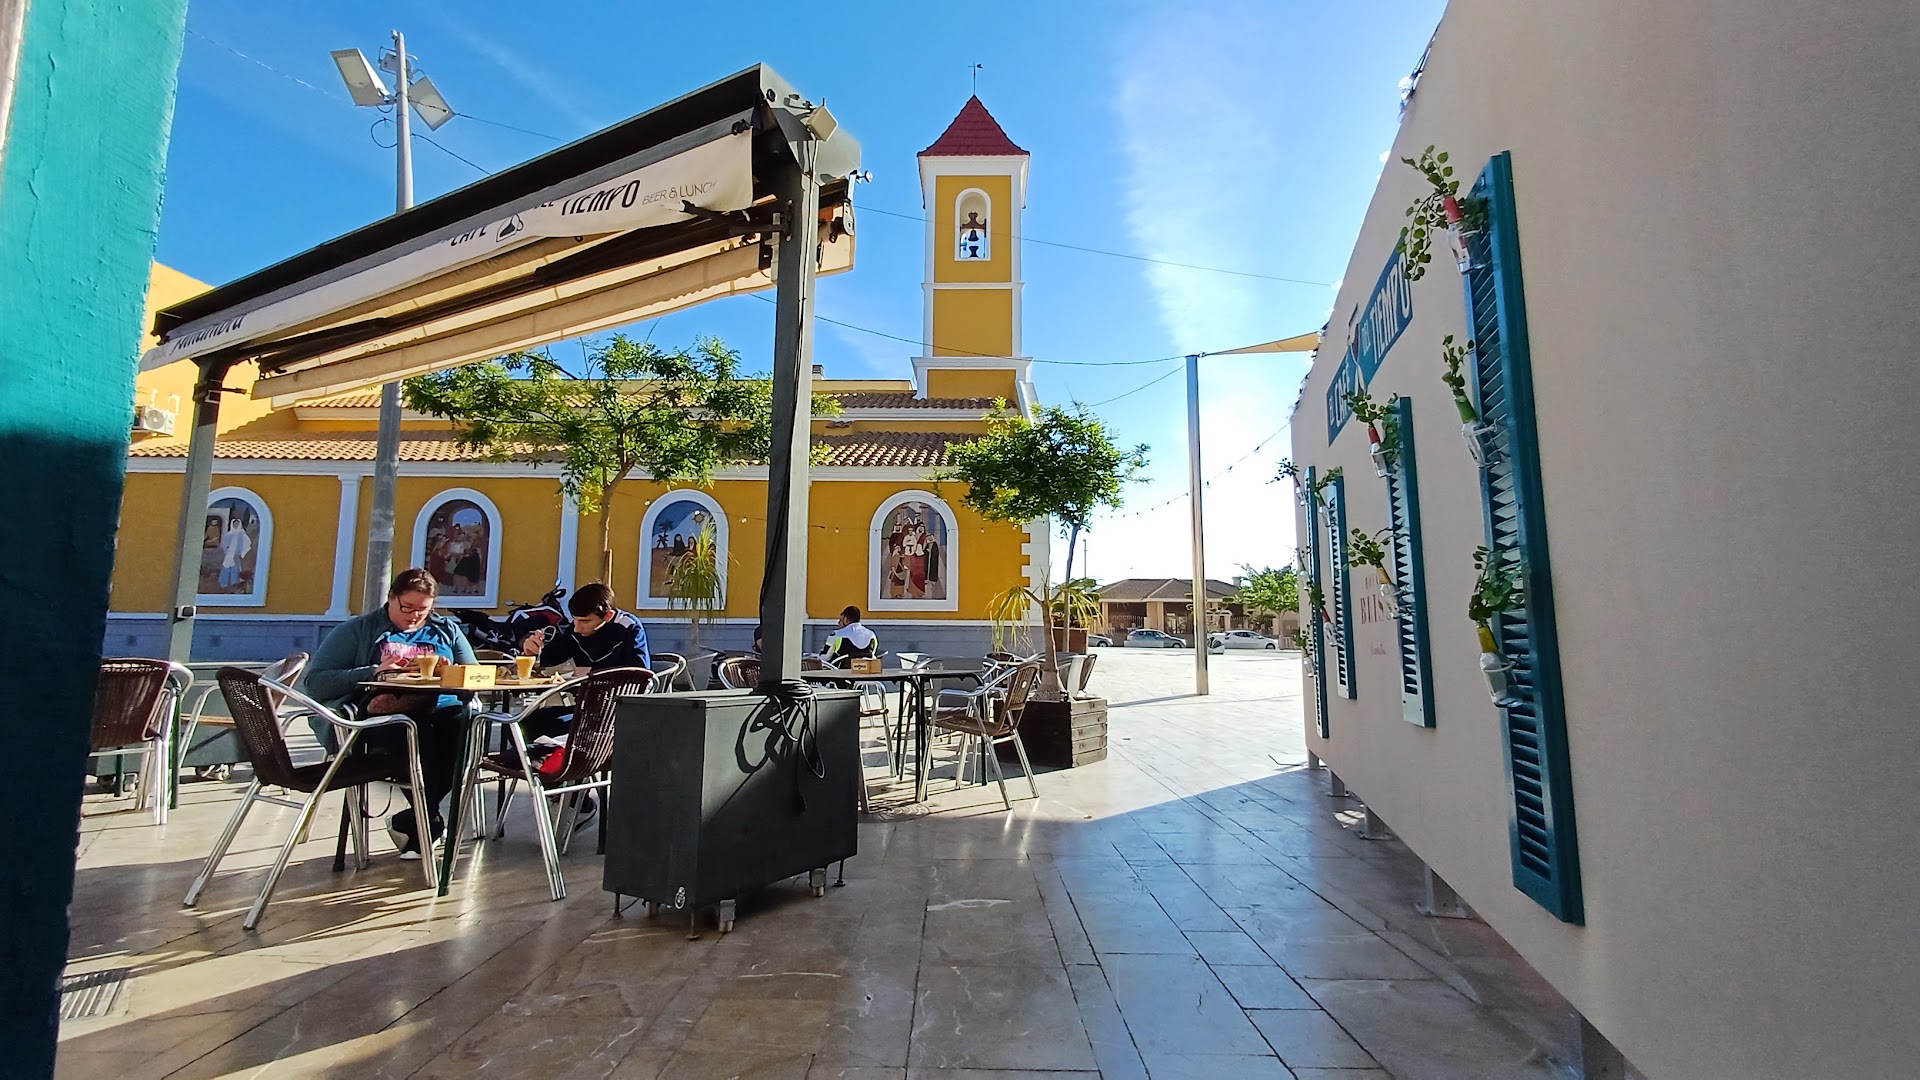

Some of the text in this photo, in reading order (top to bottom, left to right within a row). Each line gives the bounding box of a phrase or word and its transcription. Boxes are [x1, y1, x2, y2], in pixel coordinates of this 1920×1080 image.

[642, 179, 718, 205] BEER & LUNCH
[1370, 251, 1411, 364] TIEMPO
